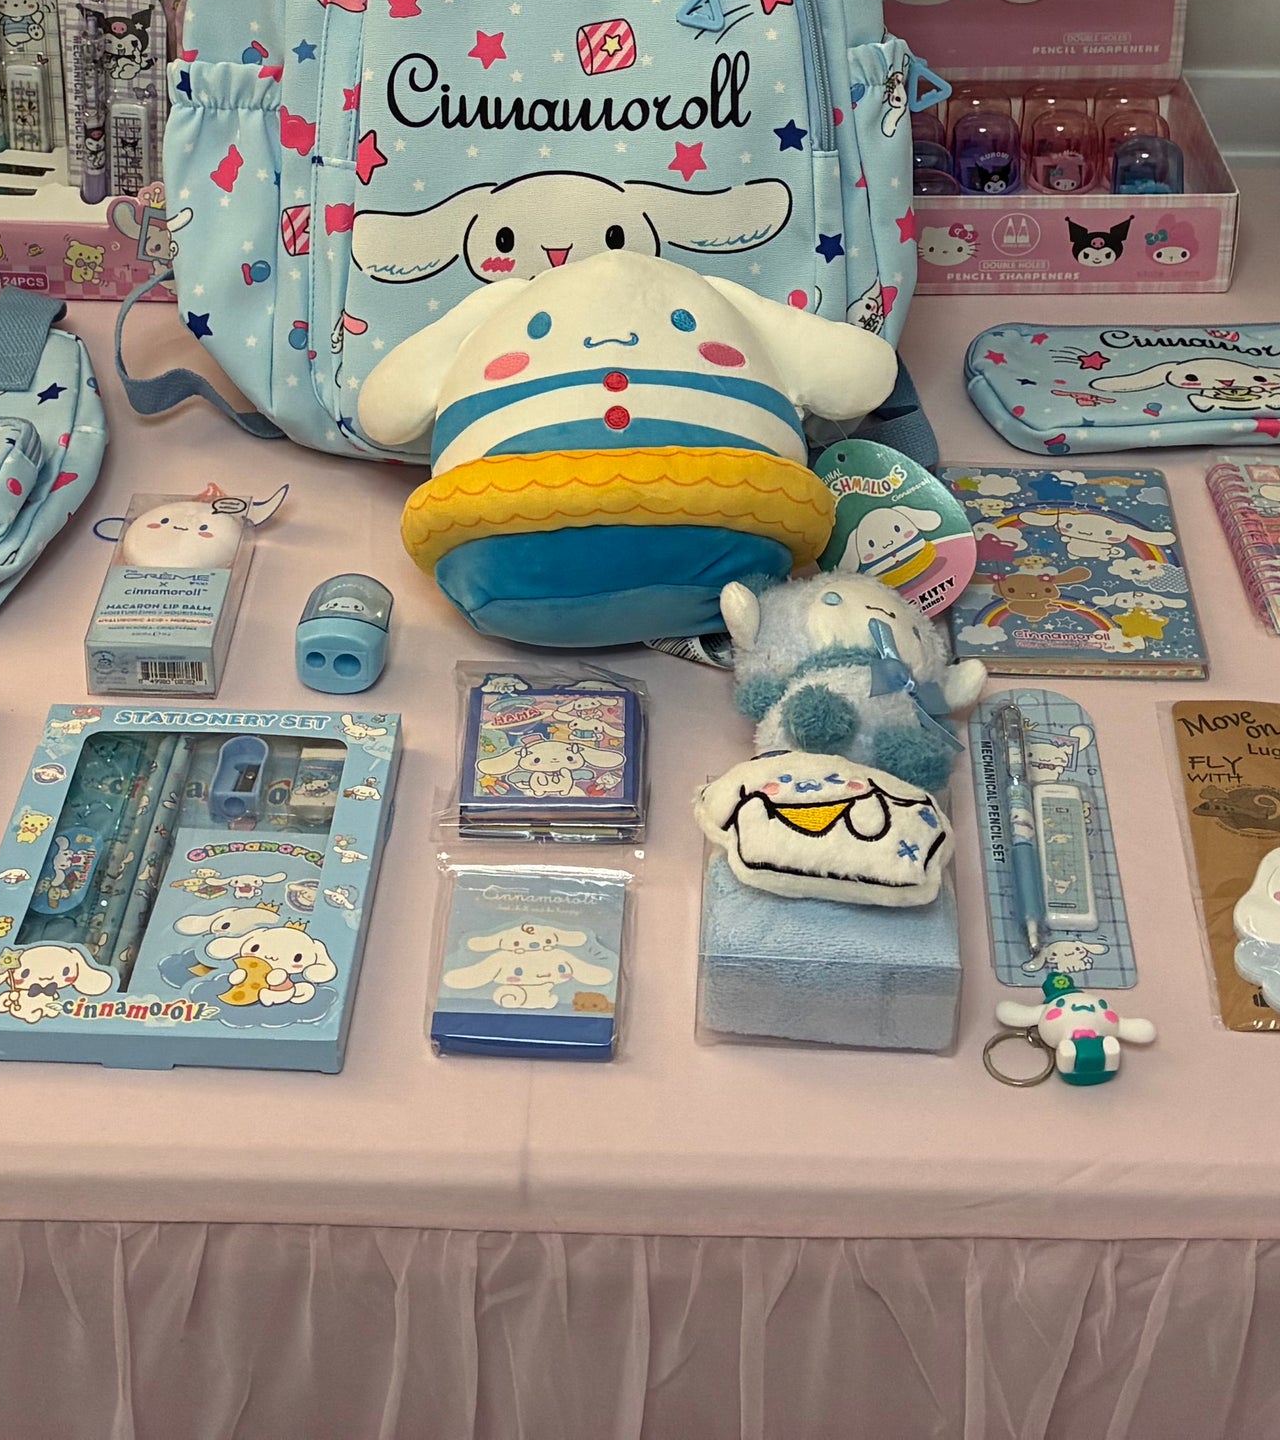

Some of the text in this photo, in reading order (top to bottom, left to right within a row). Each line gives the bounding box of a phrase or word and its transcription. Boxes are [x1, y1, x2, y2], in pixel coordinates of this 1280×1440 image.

[387, 51, 752, 132] Cinnamoroll
[2, 276, 46, 289] 24PCS
[946, 272, 993, 281] PENCIL
[831, 464, 908, 497] SHMALLOWS
[919, 574, 957, 605] KITTY
[113, 709, 332, 731] STATIONERY SET
[1178, 711, 1257, 737] Move
[1246, 722, 1280, 739] on
[1188, 756, 1243, 776] FLY
[1187, 773, 1243, 784] WITH
[981, 741, 1005, 863] MECHANICAL PENCIL SET
